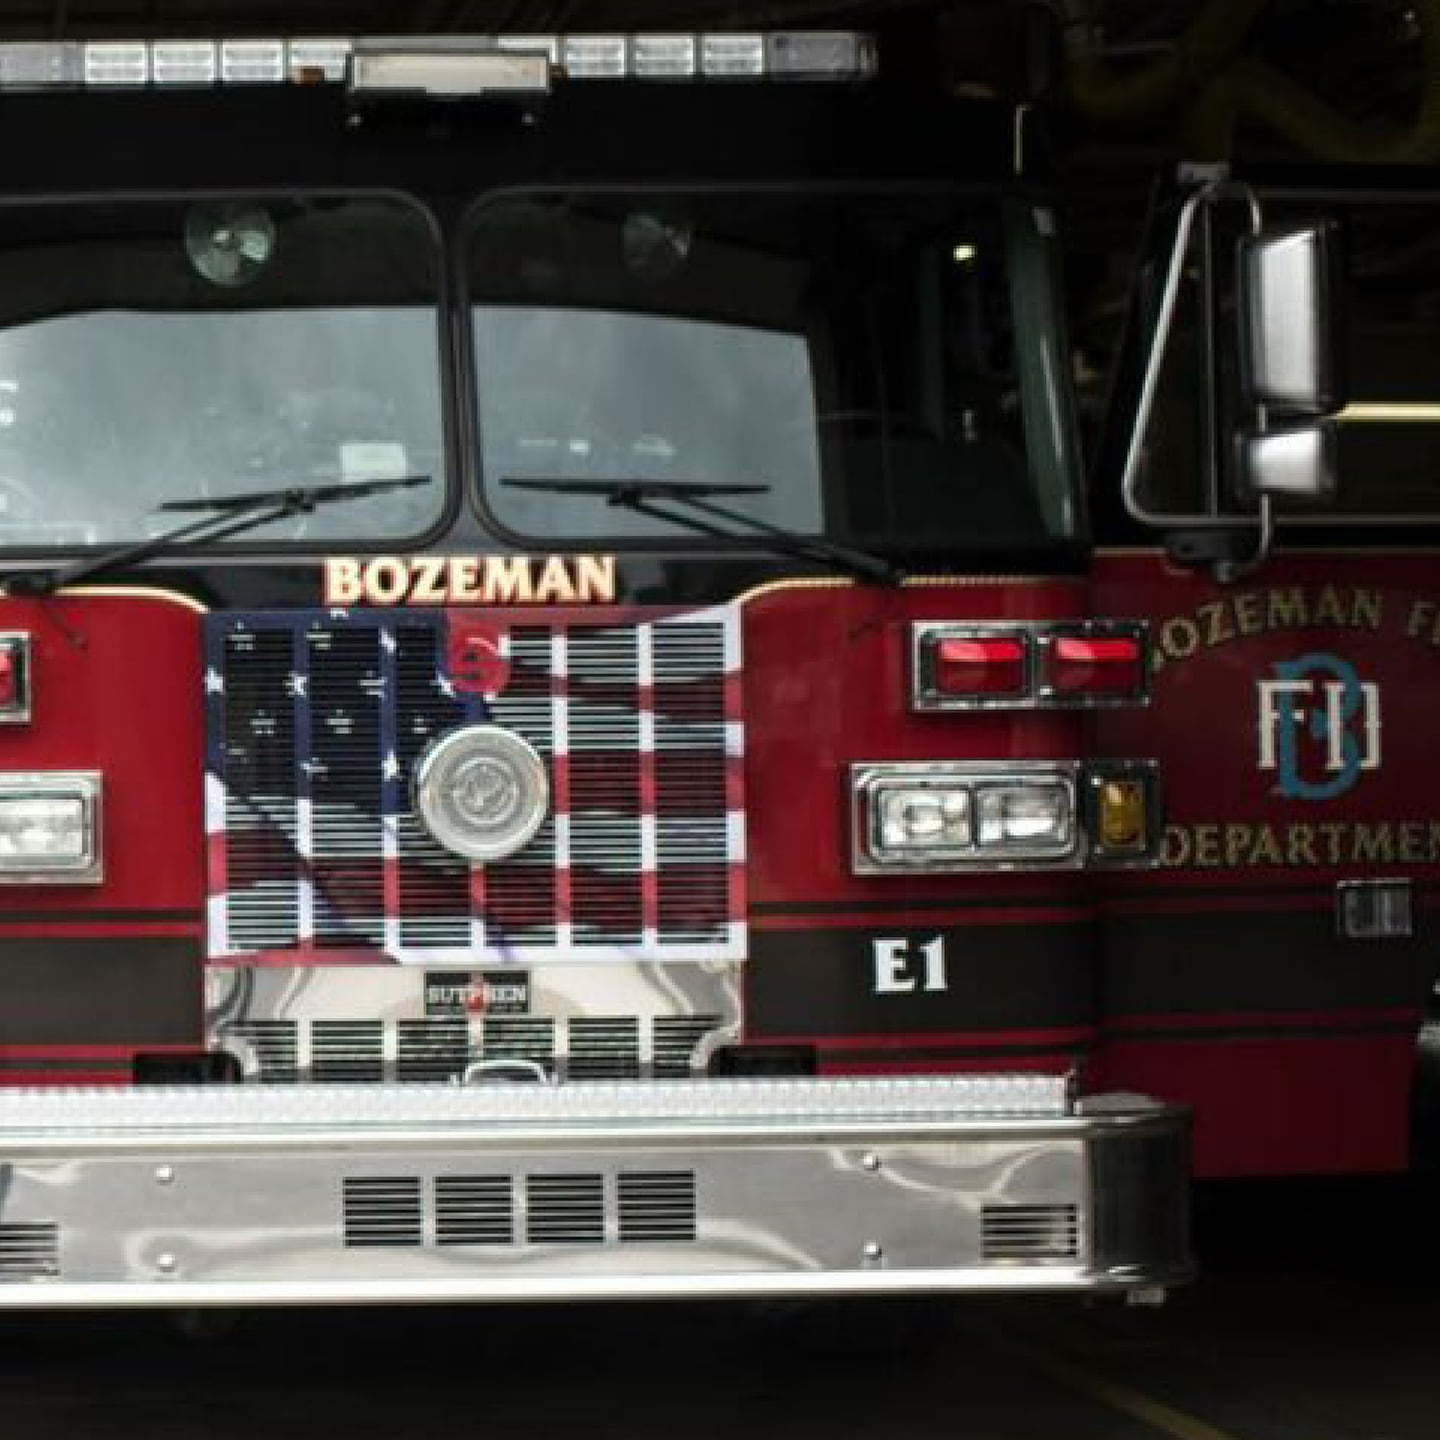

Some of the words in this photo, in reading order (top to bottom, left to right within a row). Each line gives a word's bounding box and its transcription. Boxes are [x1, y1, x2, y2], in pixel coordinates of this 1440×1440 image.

[324, 555, 617, 605] BOZEMAN
[1151, 584, 1383, 672] OZEMAN
[872, 934, 948, 994] E1
